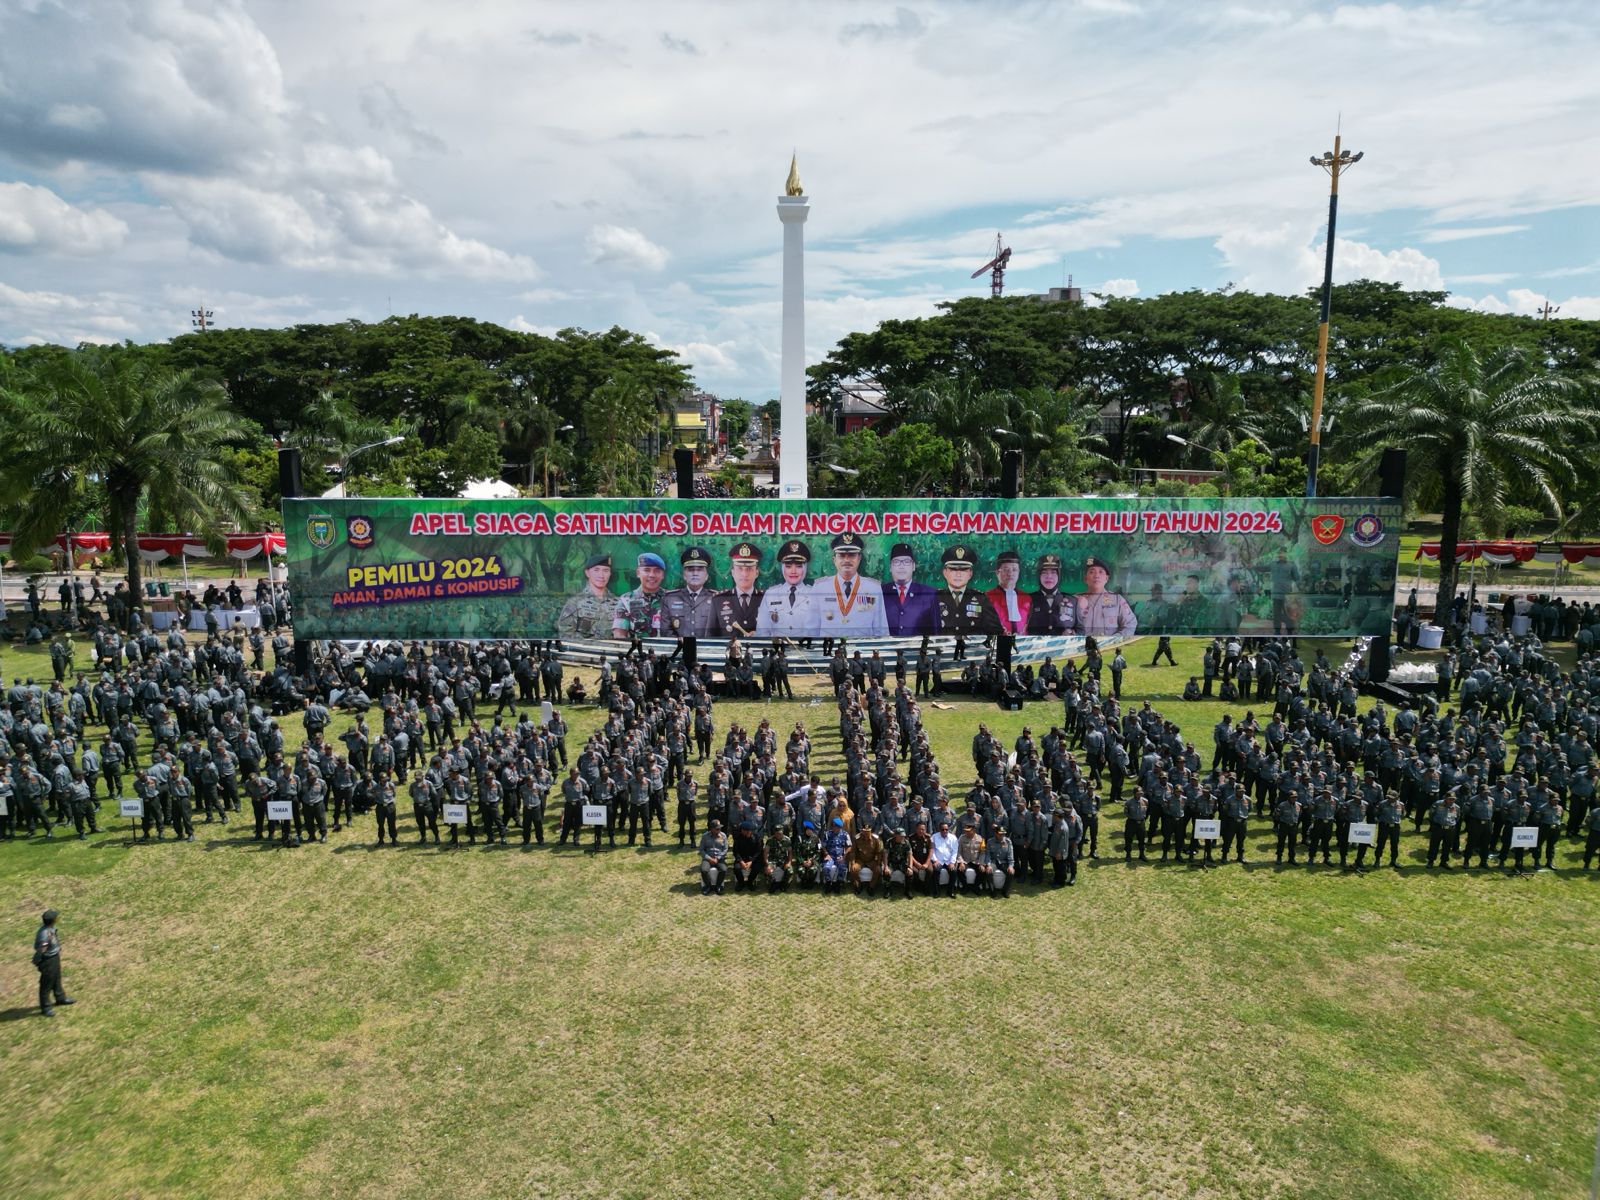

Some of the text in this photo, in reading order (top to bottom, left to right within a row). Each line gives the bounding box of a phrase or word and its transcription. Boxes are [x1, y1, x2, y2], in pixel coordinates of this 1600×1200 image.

[410, 512, 470, 535] APEL
[475, 512, 551, 535] SIAGA
[554, 512, 688, 535] SATLINMAS
[691, 512, 774, 535] DALAM
[778, 512, 880, 535] RANGKA
[883, 512, 1049, 534] PENGAMANAN
[1053, 511, 1138, 534] PEMILU
[1142, 511, 1221, 533] TAHUN
[1224, 511, 1282, 533] 2024
[348, 556, 500, 588] PEMILU 2024
[332, 578, 519, 605] AMAN, DAMAI & KONDUSIF
